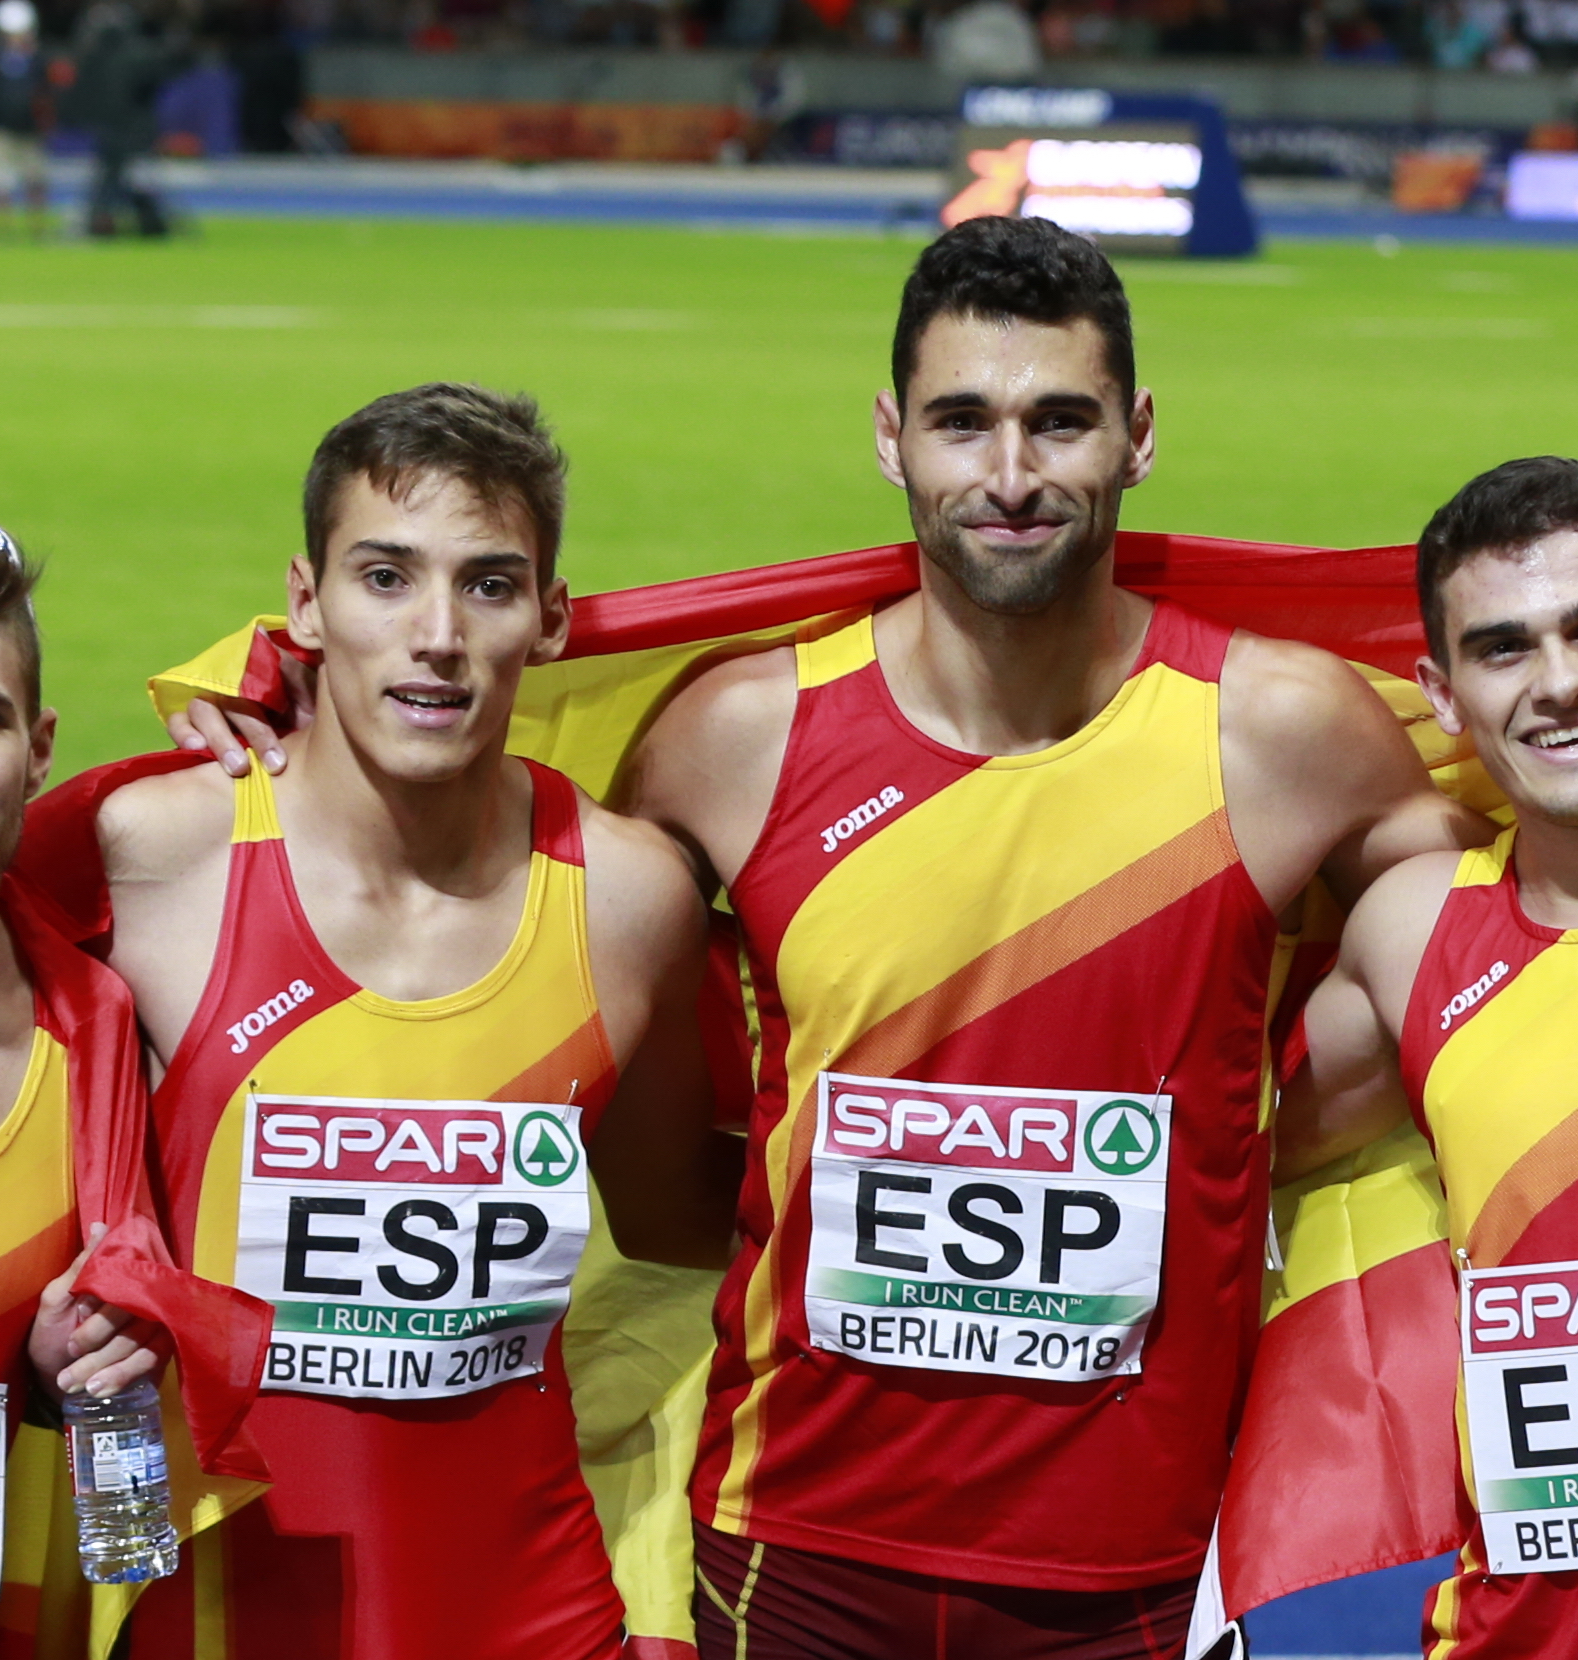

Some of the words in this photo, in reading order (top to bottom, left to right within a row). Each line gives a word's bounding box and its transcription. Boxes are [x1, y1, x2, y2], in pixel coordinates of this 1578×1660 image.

[261, 1113, 501, 1174] SPAR
[833, 1093, 1069, 1162] SPAR
[283, 1196, 549, 1301] ESP
[855, 1170, 1121, 1285] ESP
[316, 1306, 323, 1330] I
[334, 1308, 397, 1334] RUN
[884, 1280, 892, 1303] I
[901, 1283, 963, 1308] RUN
[267, 1341, 434, 1389] BERLIN
[444, 1335, 527, 1387] 2018
[840, 1311, 999, 1363] BERLIN
[1013, 1329, 1121, 1373] 2018
[1547, 1480, 1556, 1504] I
